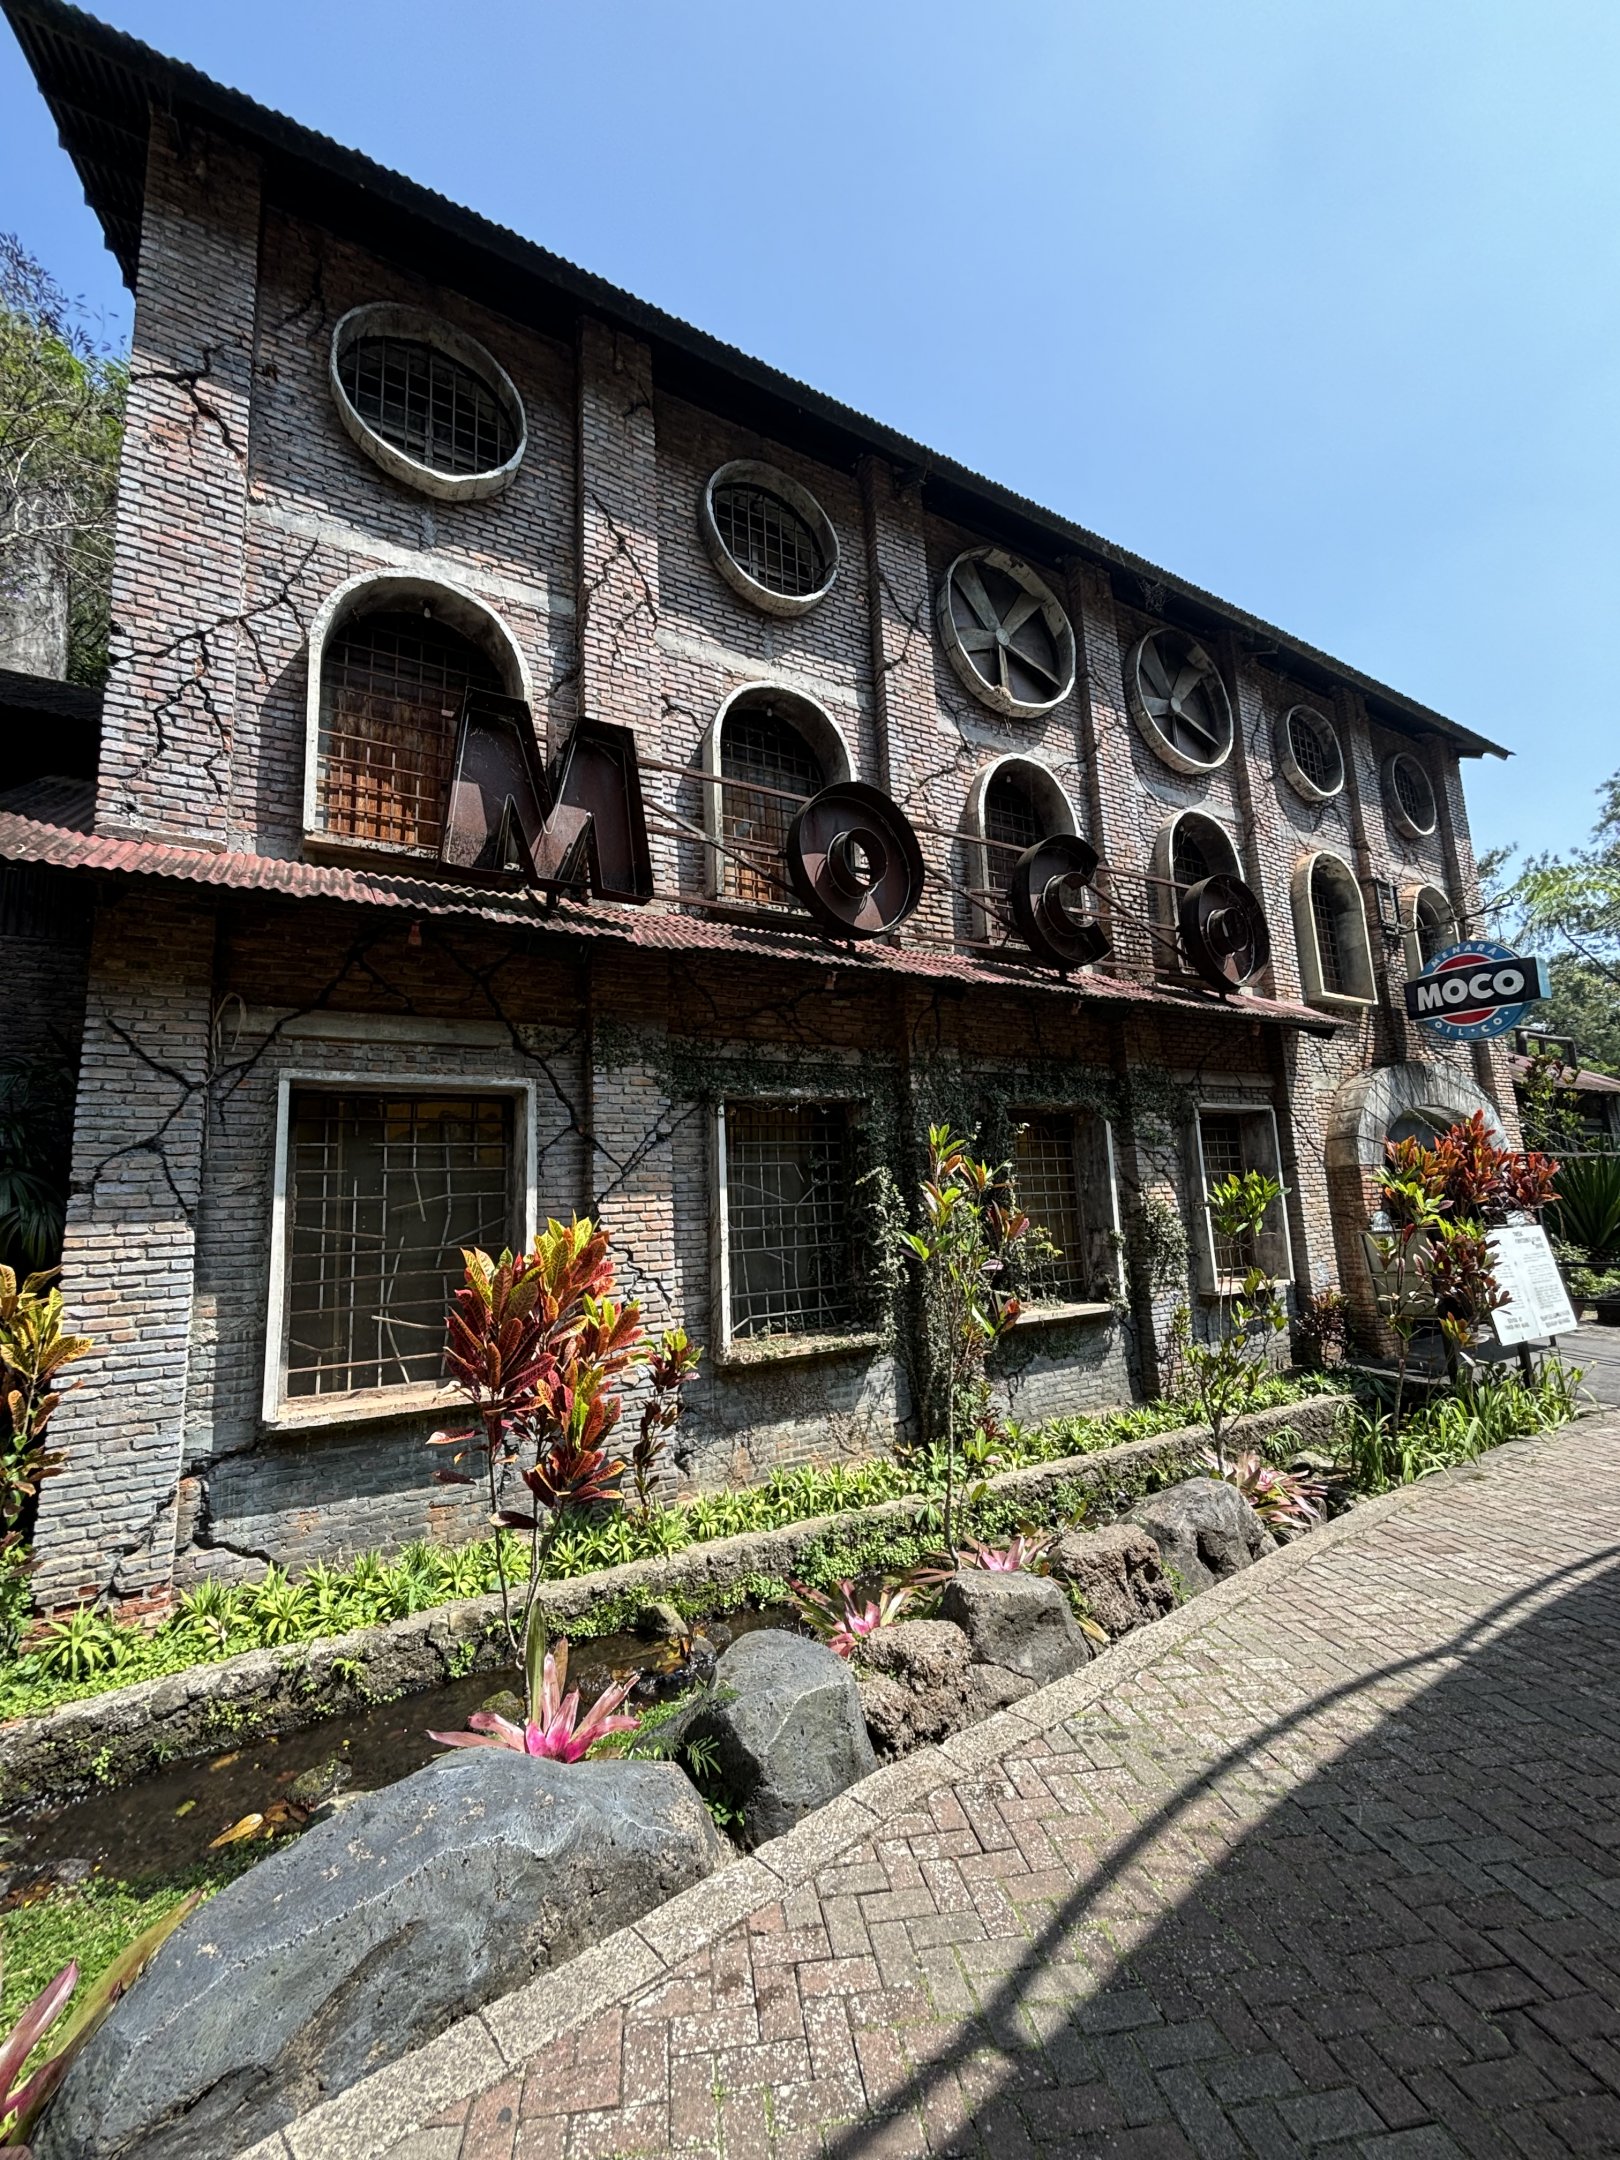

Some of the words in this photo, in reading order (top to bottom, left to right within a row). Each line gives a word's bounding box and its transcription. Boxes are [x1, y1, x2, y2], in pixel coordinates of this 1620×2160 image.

[437, 688, 1270, 990] MOCO
[1431, 943, 1497, 967] MENARA
[1417, 969, 1525, 1011] MOCO
